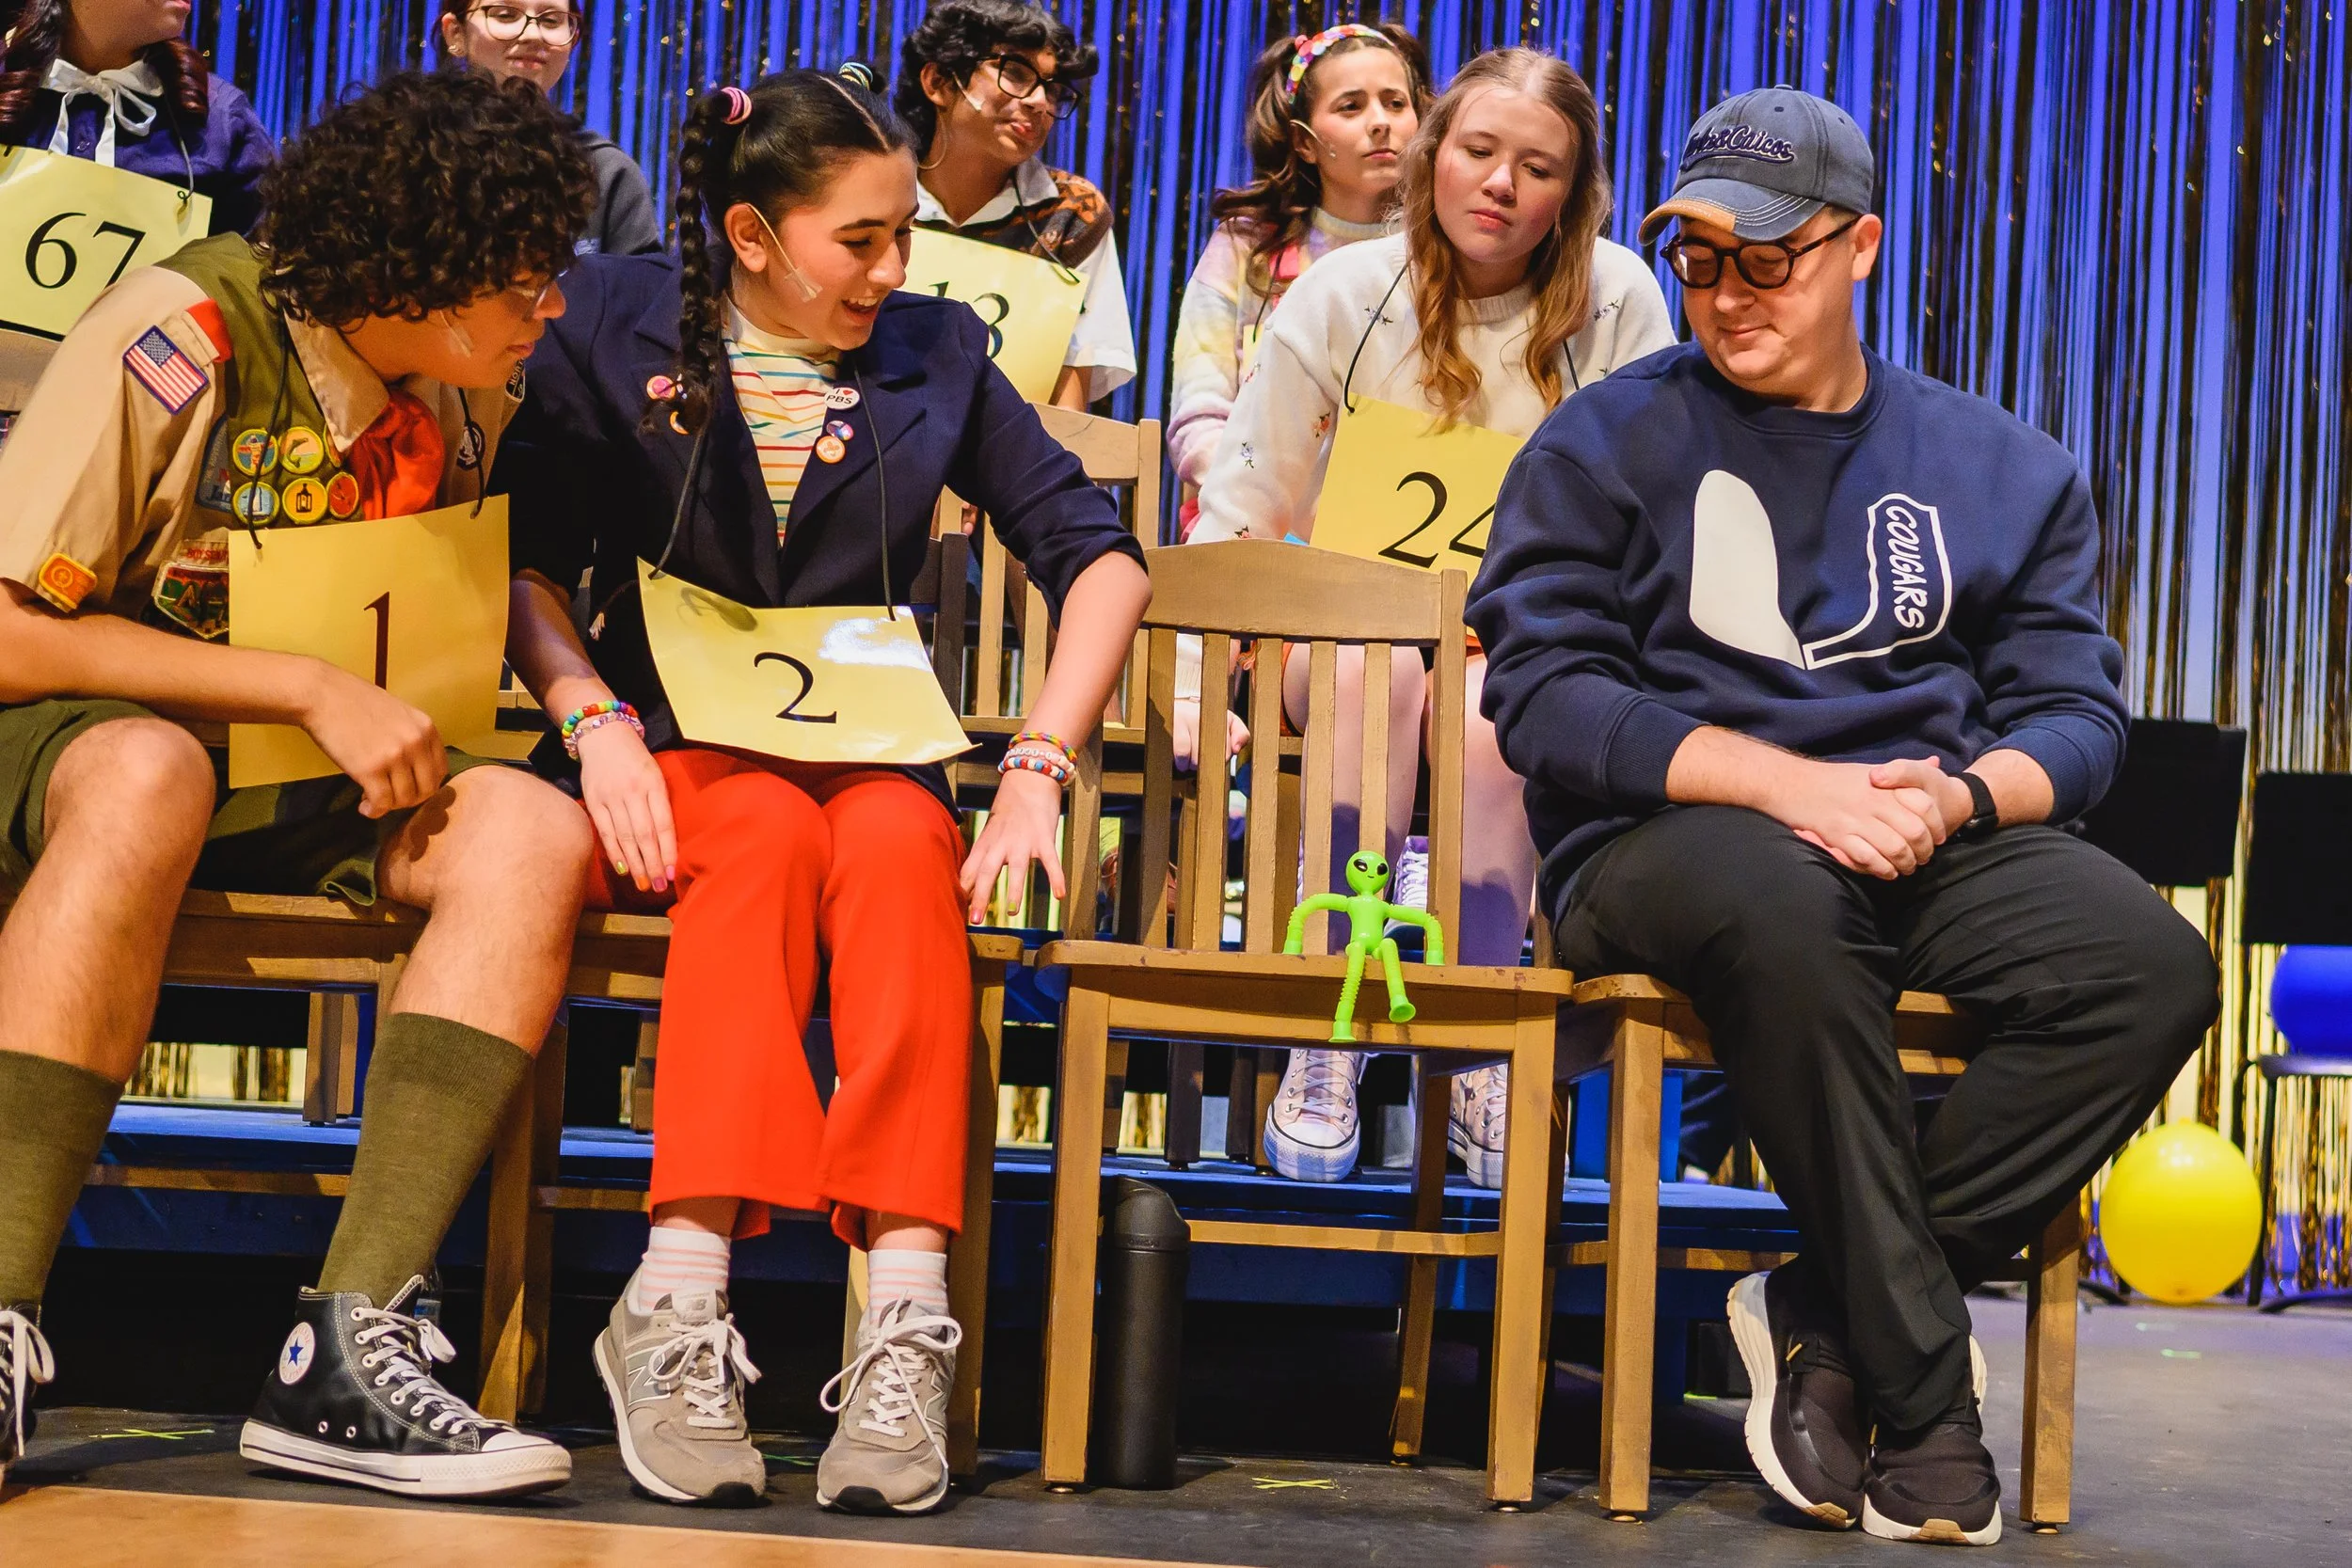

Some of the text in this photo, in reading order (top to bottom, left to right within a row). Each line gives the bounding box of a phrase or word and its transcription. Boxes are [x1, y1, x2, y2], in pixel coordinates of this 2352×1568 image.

[24, 212, 147, 289] 67
[826, 394, 853, 404] PBS
[1885, 505, 1928, 629] COUGARS
[363, 591, 390, 690] 1
[754, 651, 837, 724] 2
